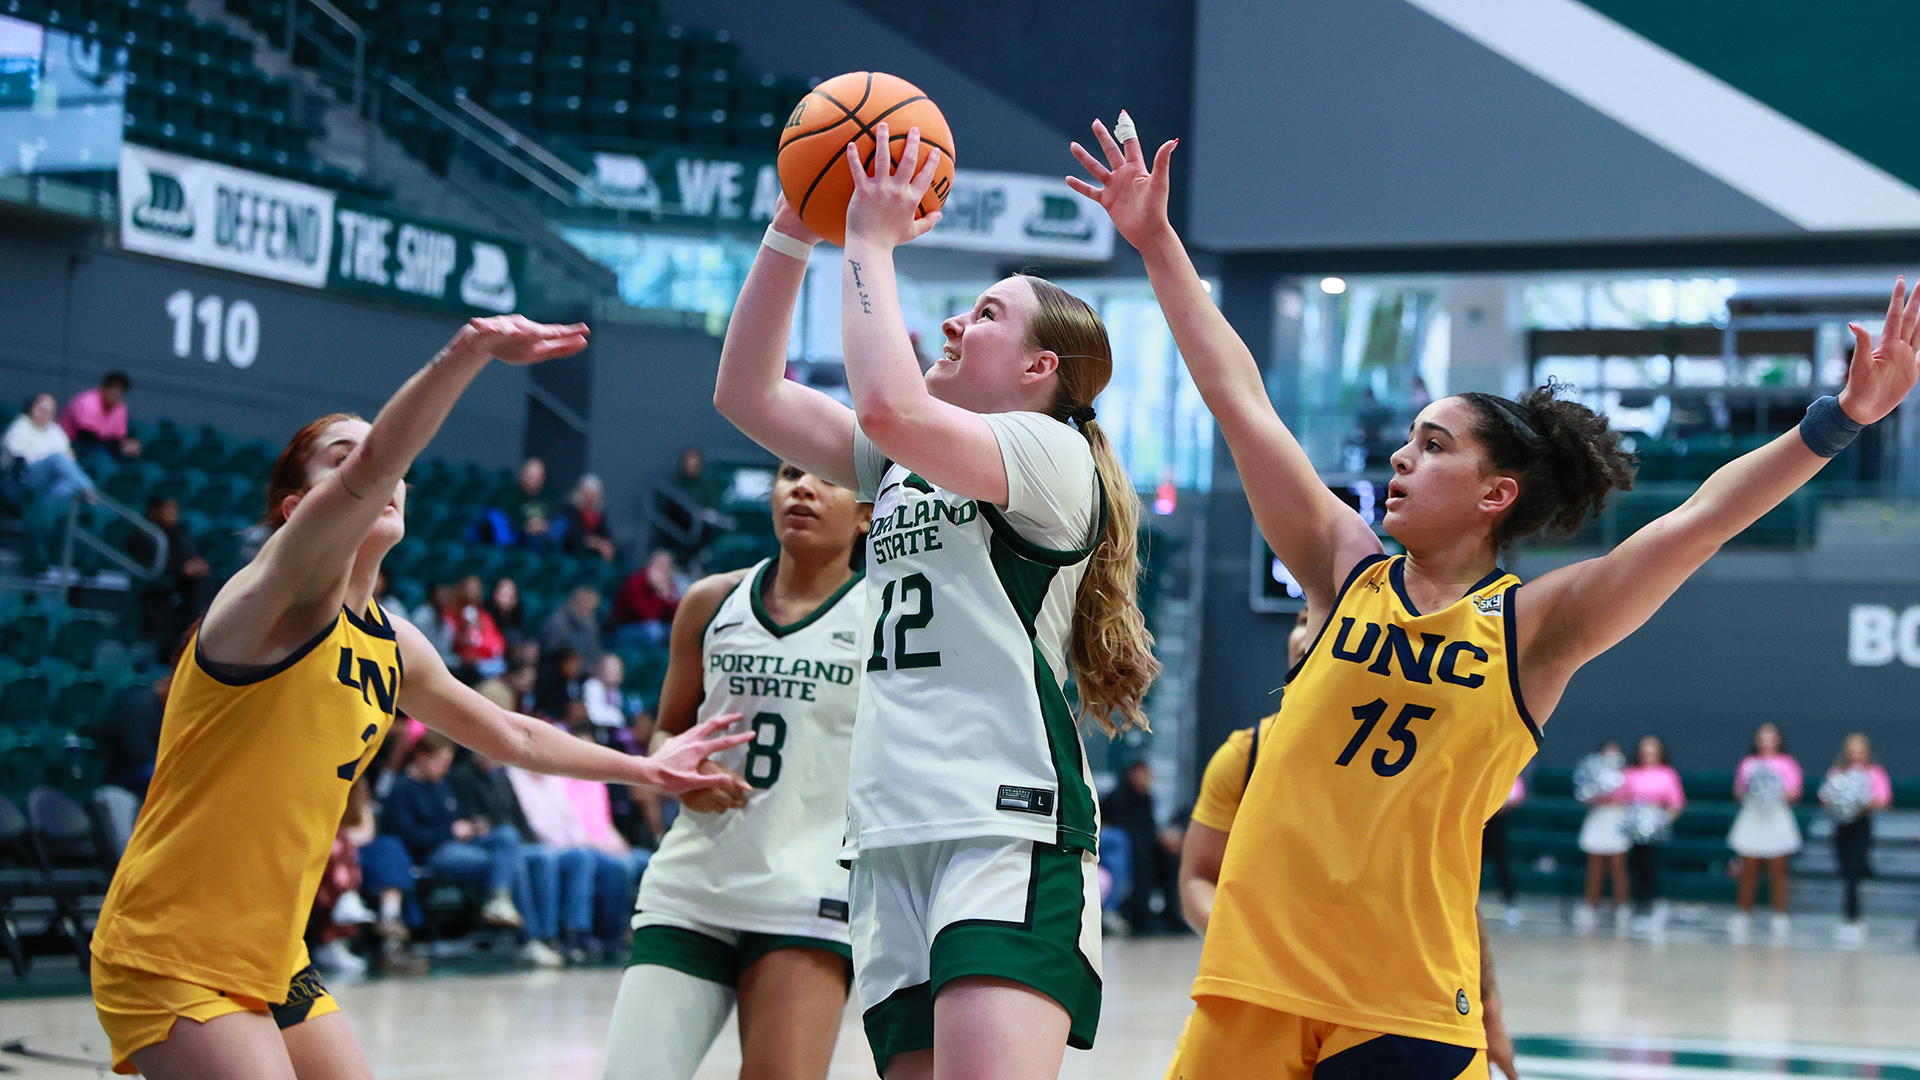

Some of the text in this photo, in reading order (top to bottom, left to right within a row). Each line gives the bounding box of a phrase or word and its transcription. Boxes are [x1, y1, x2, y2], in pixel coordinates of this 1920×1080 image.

[675, 157, 745, 219] WE
[215, 183, 457, 298] DEFEND THE SHIP
[165, 289, 260, 369] 110
[873, 525, 943, 565] STATE
[866, 572, 941, 672] 12
[1480, 595, 1501, 609] SKY
[710, 654, 854, 685] PORTLAND
[1332, 616, 1488, 689] UNC
[729, 677, 817, 701] STATE
[744, 711, 787, 789] 8
[1334, 697, 1436, 777] 15
[1038, 796, 1044, 806] L
